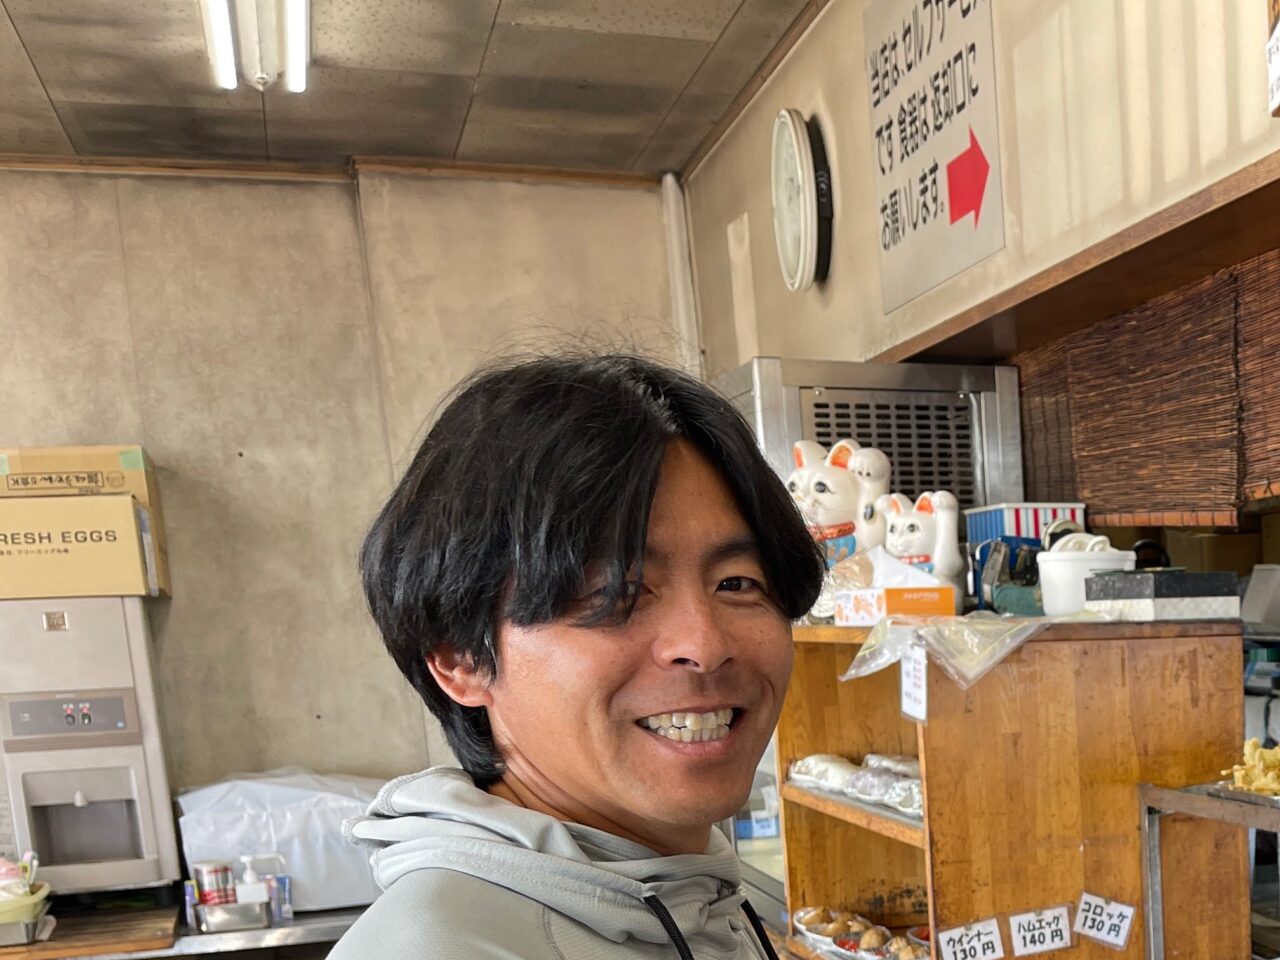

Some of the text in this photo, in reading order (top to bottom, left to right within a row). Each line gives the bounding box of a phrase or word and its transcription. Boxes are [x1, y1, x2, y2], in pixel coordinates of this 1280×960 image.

[880, 158, 944, 251] お願いします。
[61, 530, 118, 544] EGGS
[1081, 900, 1129, 924] コロッケ
[1017, 913, 1064, 935] ハムエッグ
[1081, 915, 1122, 938] 130円
[945, 927, 994, 948] ウインナー
[1021, 928, 1065, 949] 140円
